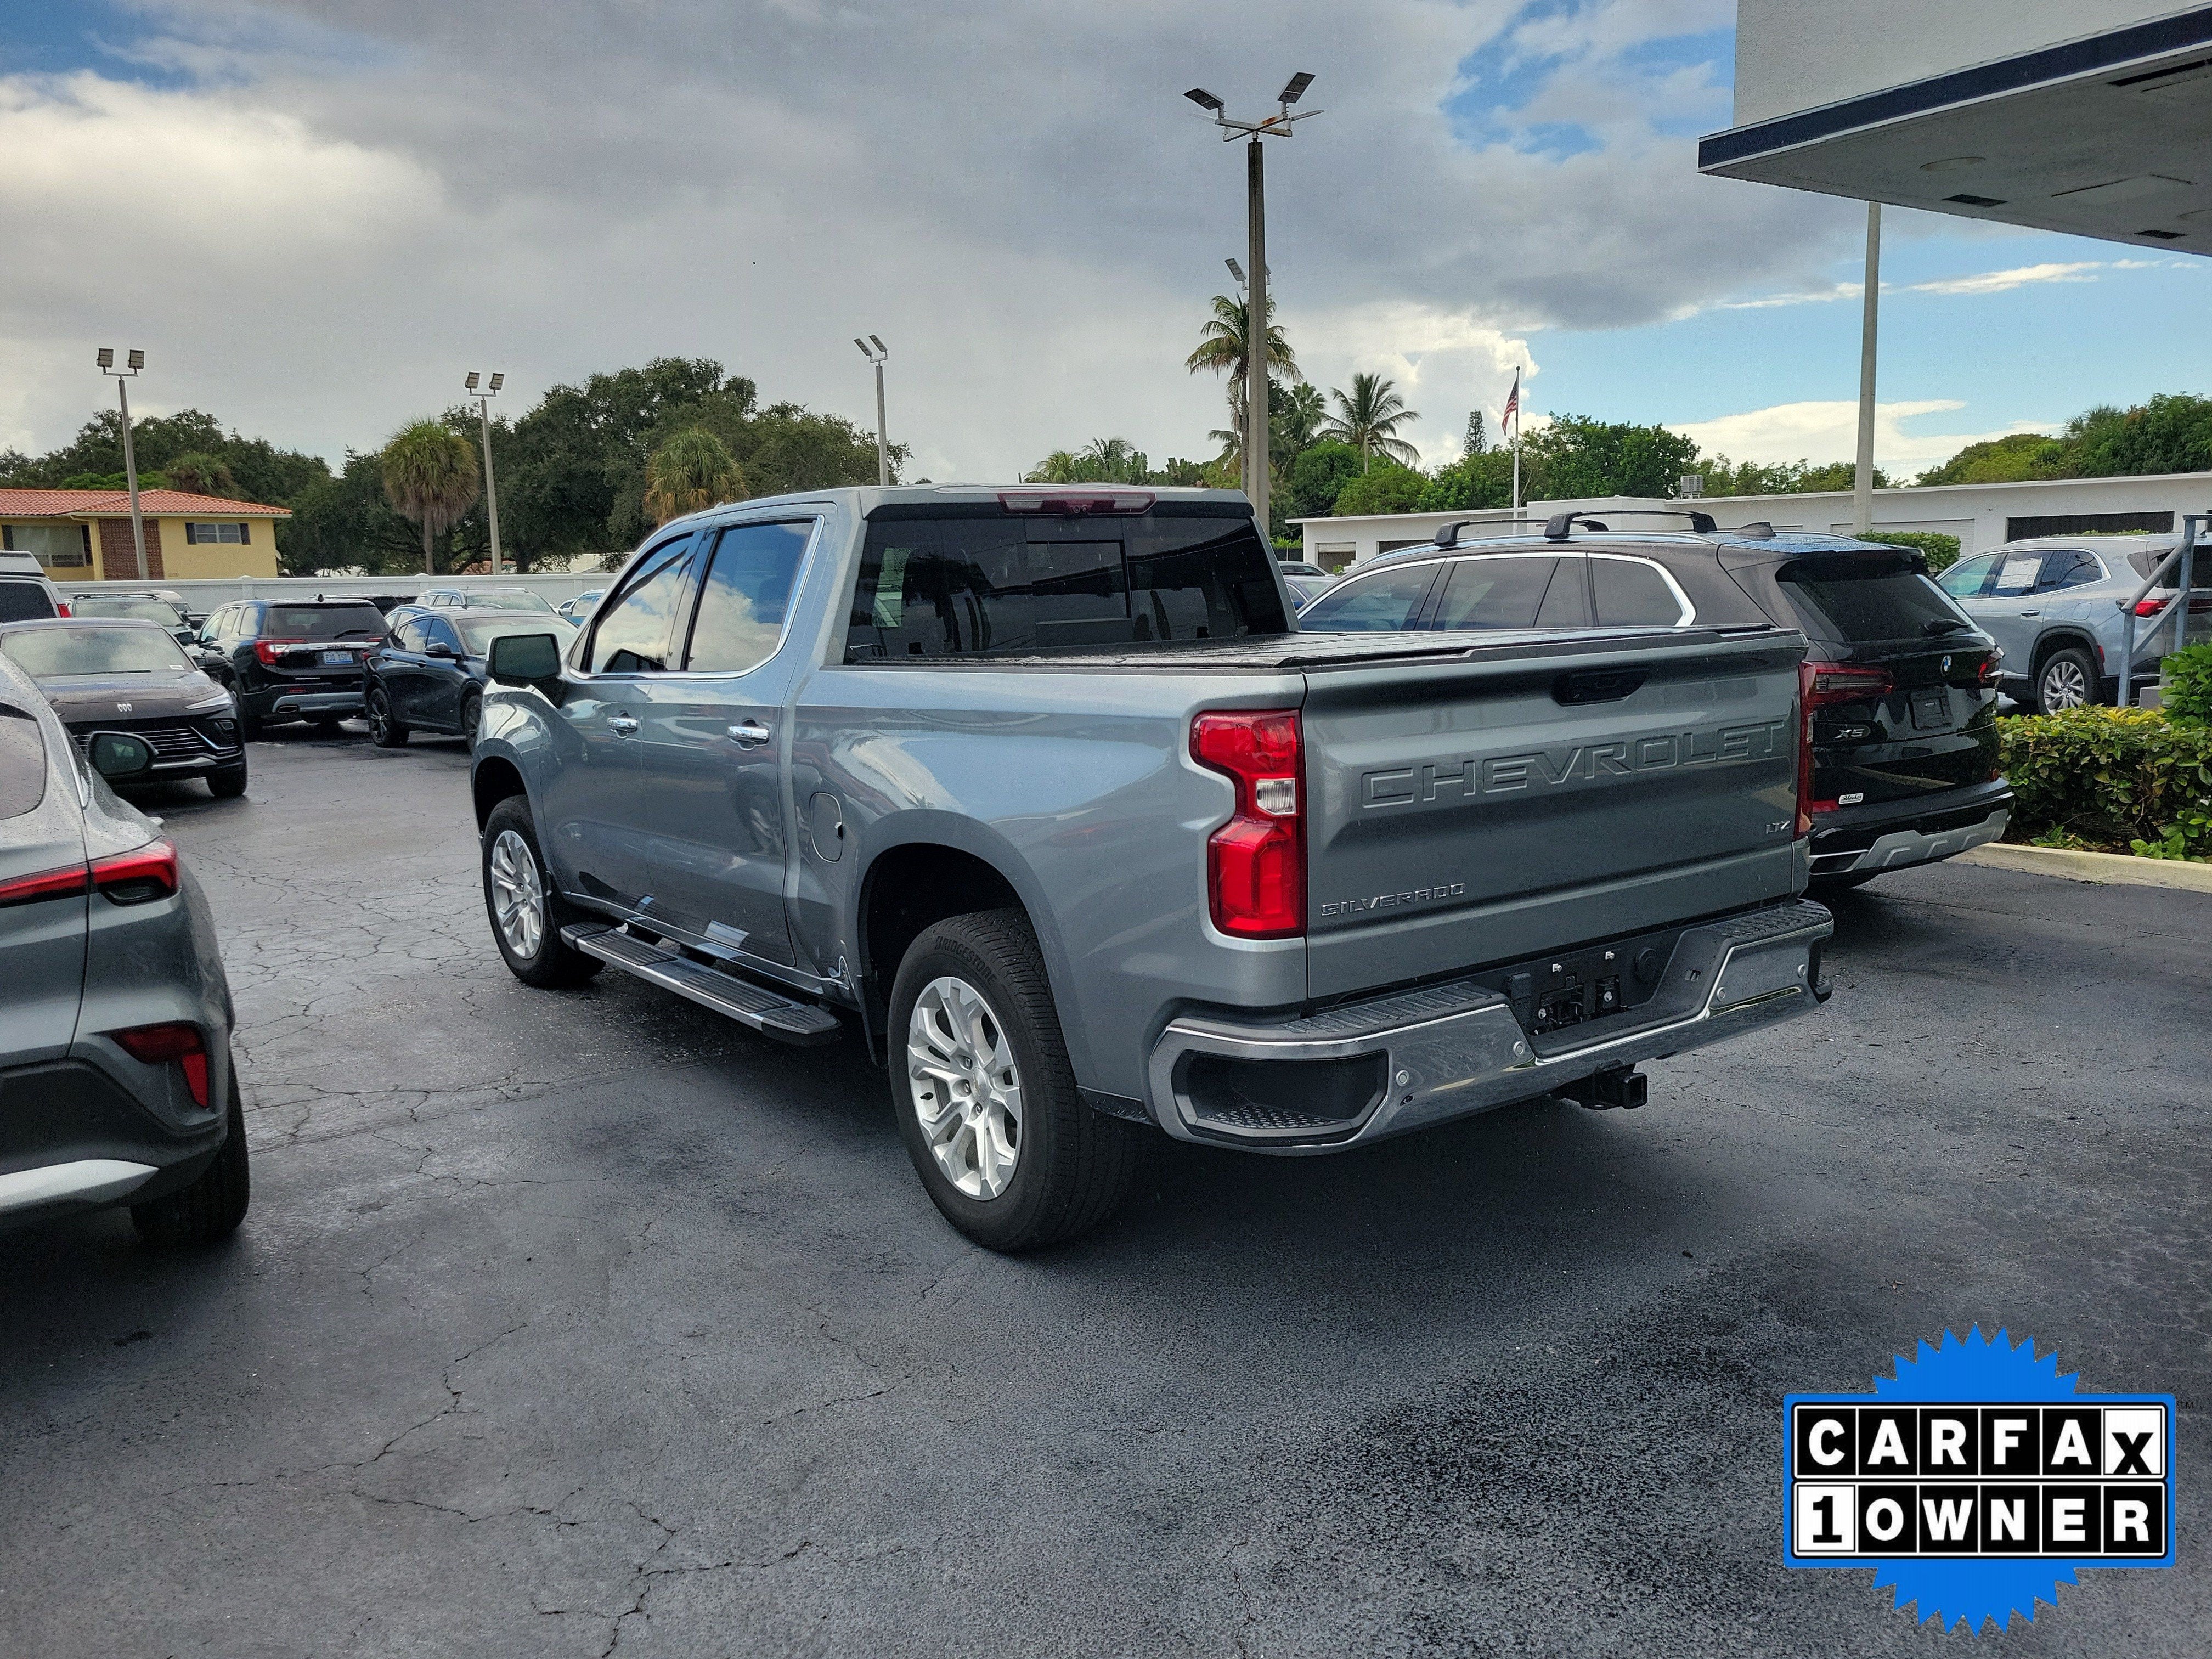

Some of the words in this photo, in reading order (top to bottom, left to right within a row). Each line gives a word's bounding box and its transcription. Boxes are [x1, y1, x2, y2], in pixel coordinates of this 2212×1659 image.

[1833, 728, 1864, 739] X5
[1361, 721, 1785, 809] CHEVROLET
[1765, 821, 1791, 834] LTZ
[1322, 883, 1465, 917] SILVERADO
